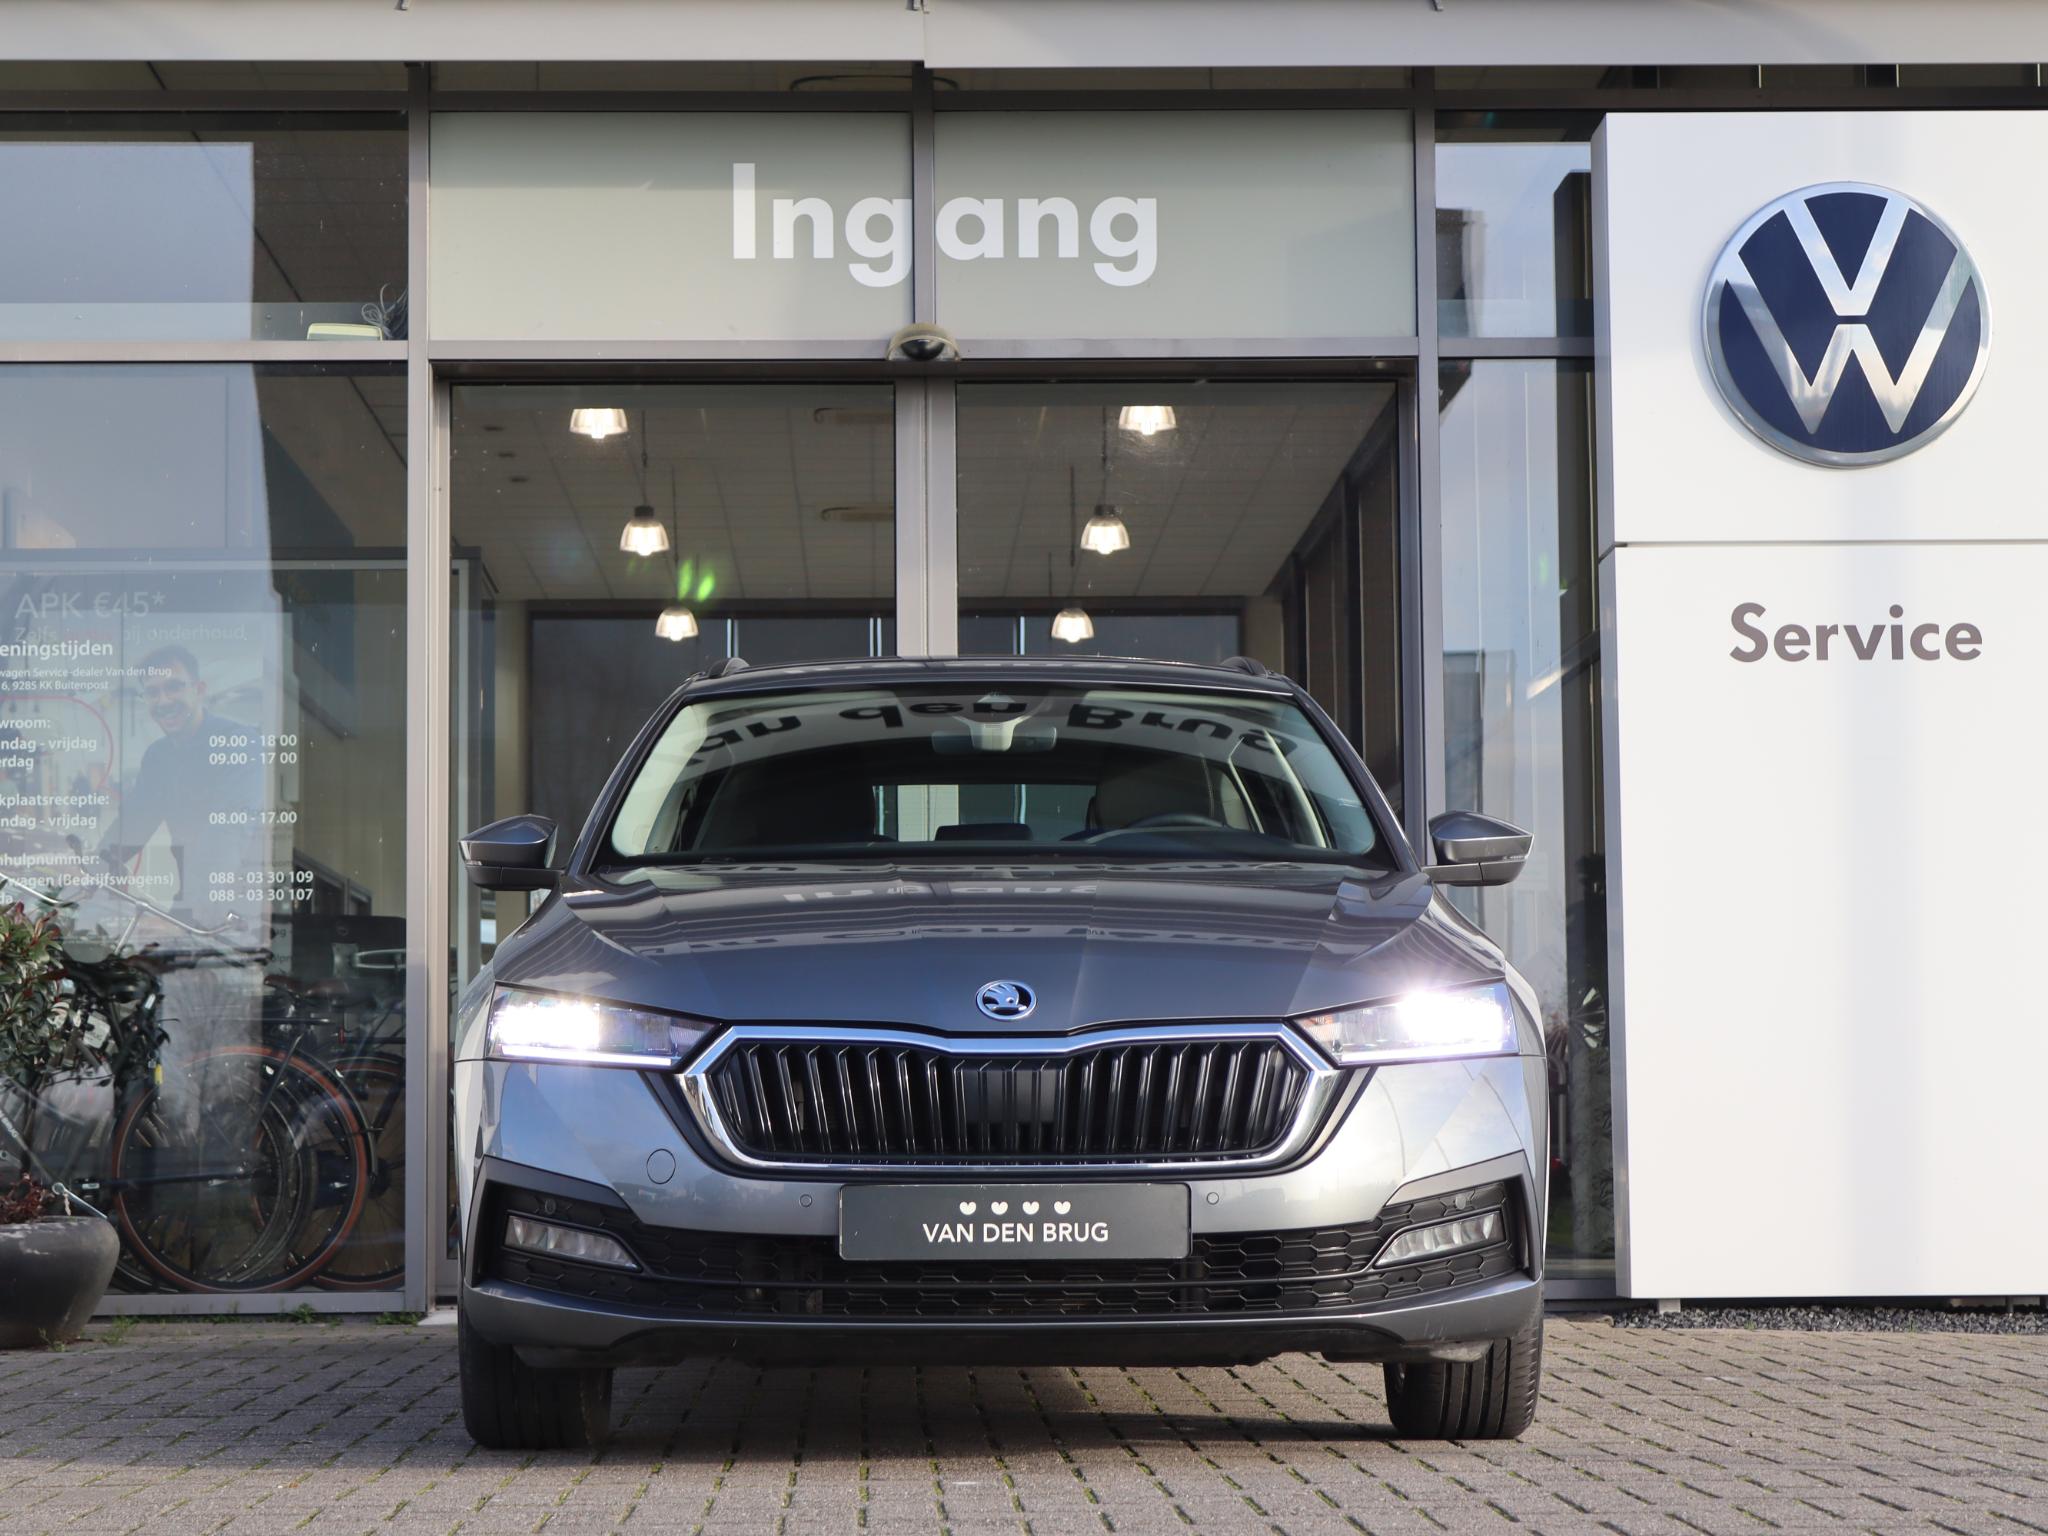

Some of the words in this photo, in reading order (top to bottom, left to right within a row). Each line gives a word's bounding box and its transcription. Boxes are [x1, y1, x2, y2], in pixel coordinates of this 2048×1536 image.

[732, 162, 1158, 287] Ingang
[14, 592, 83, 619] APK
[1729, 602, 1983, 663] Service
[33, 667, 104, 678] Service-dealer
[106, 666, 124, 677] Van
[126, 666, 146, 677] den
[148, 666, 173, 679] Brug
[12, 681, 37, 691] 9285
[40, 681, 54, 690] KK
[55, 680, 109, 691] Buitenpost
[48, 736, 97, 752] vrijdag
[208, 735, 248, 747] 09.00
[260, 734, 298, 747] 1800
[0, 754, 34, 770] rdag
[208, 752, 248, 765] 09.00
[260, 752, 298, 765] 1700
[48, 814, 97, 829] vrijdag
[208, 812, 248, 825] 08.00
[260, 811, 298, 824] 17.00
[58, 872, 174, 889] (Bedrijfswagens)
[208, 871, 236, 884] 088
[246, 871, 264, 884] 03
[267, 871, 285, 883] 30
[289, 870, 314, 883] 109
[208, 889, 236, 902] 088
[246, 889, 264, 902] 03
[267, 889, 285, 901] 30
[289, 888, 314, 901] 107
[923, 1223, 974, 1244] VAN
[983, 1223, 1034, 1243] DEN
[1043, 1222, 1109, 1243] BRUG
